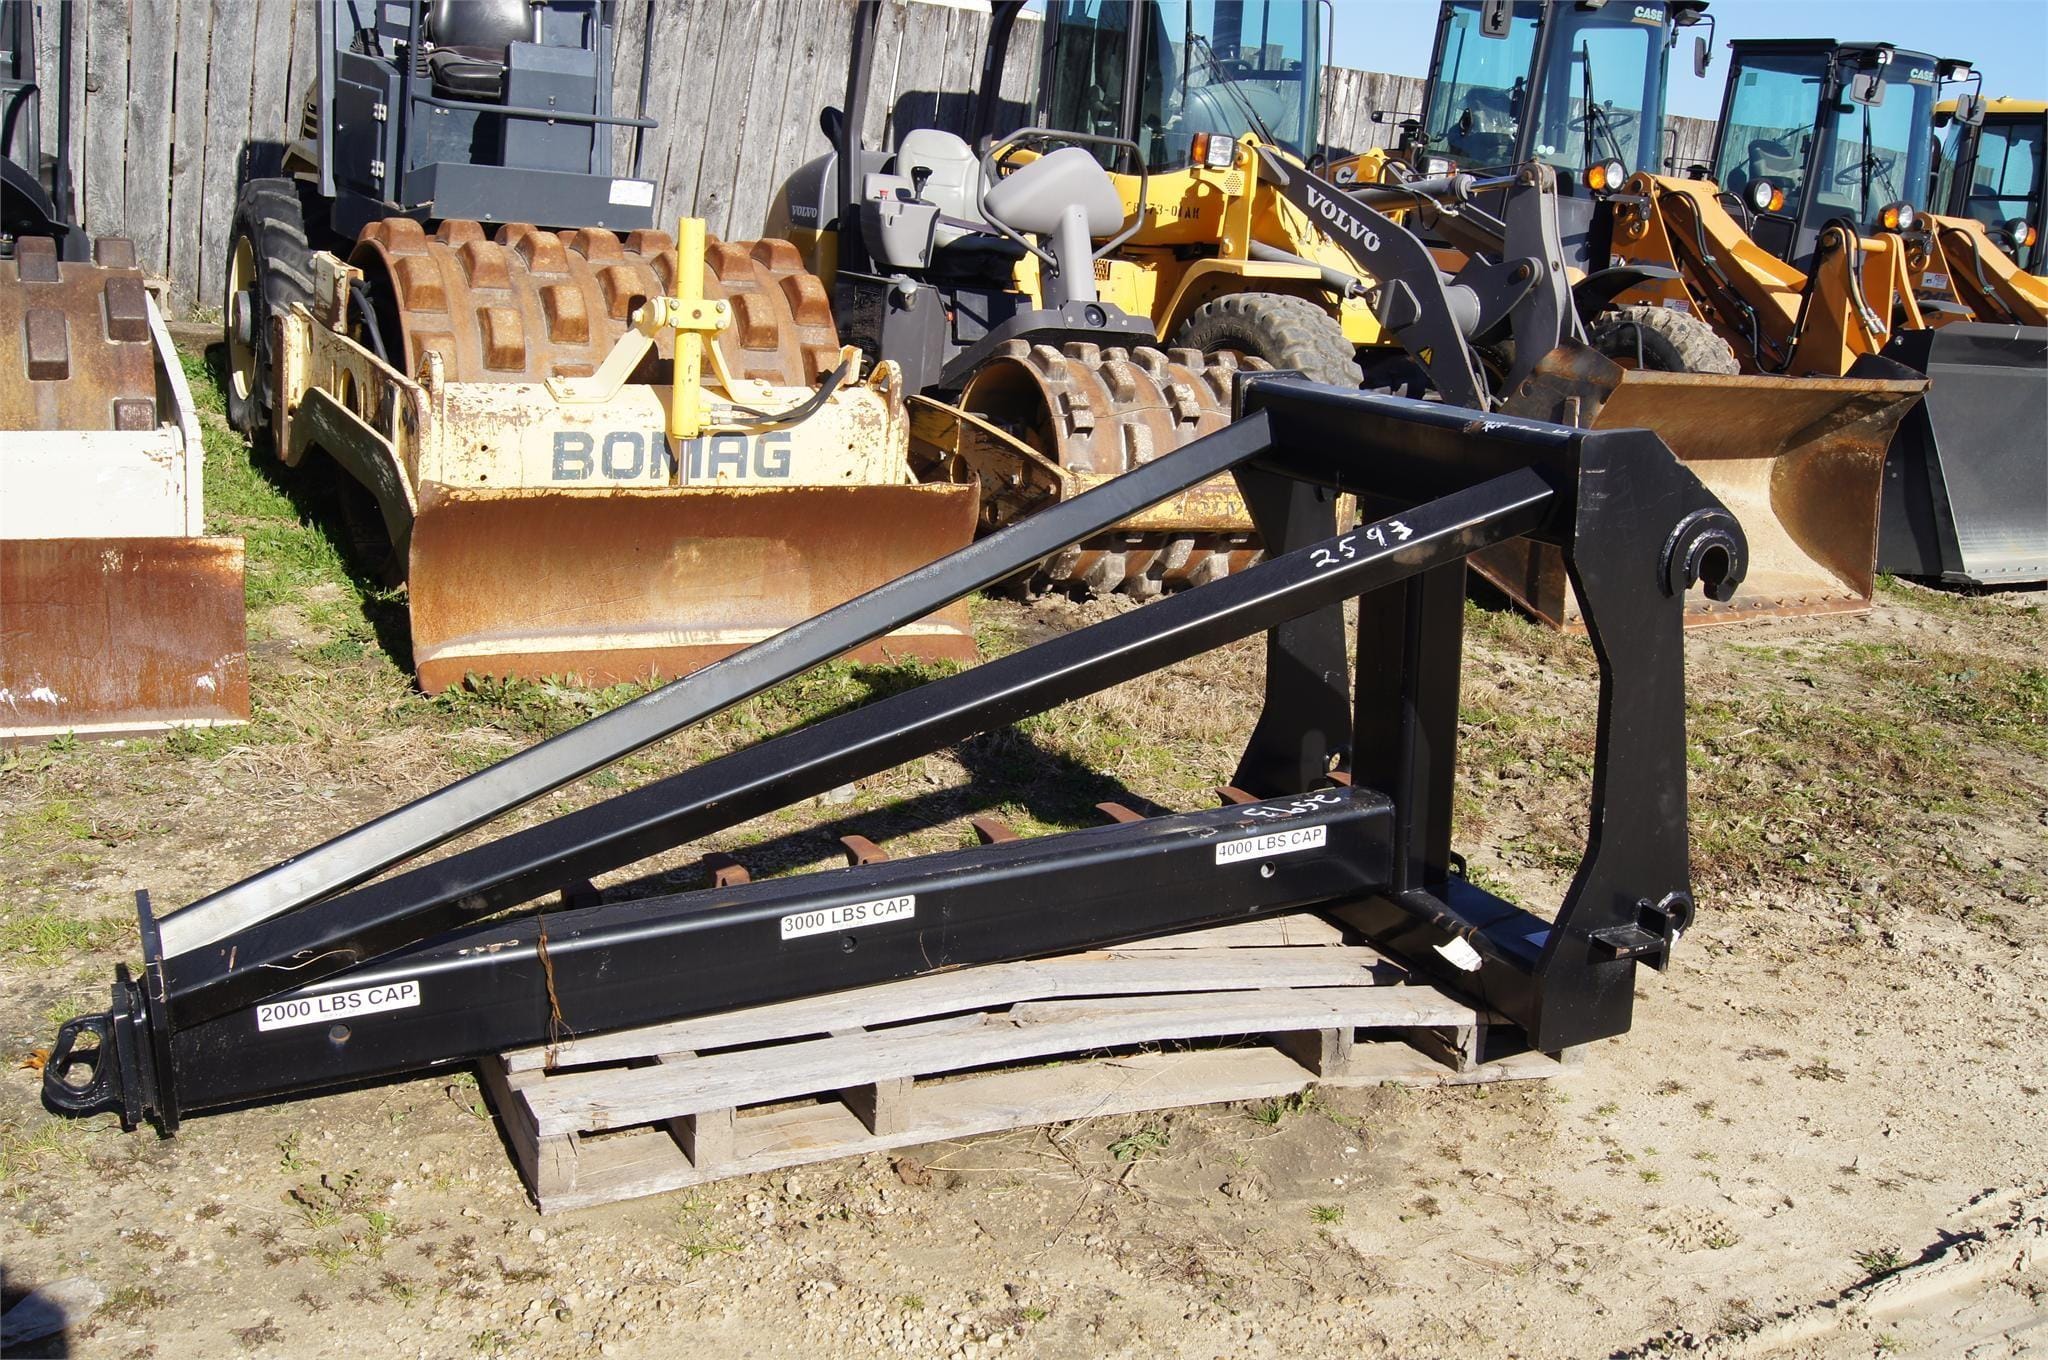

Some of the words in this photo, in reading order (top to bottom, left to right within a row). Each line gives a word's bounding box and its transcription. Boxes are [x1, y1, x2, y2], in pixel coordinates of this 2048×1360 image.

[1634, 5, 1663, 21] CASE
[1910, 68, 1934, 81] CASE
[791, 204, 818, 218] VOLVO
[1306, 184, 1381, 252] VOLVO
[552, 431, 791, 481] BOMAG
[1309, 520, 1414, 568] 2593
[1218, 841, 1252, 857] 4000
[1257, 834, 1286, 851] LBS
[784, 912, 825, 932] 3000
[831, 905, 866, 924] LBS
[873, 898, 913, 916] CAP.
[261, 1001, 311, 1022] 2000
[318, 993, 362, 1013] LBS
[368, 984, 417, 1005] CAP.
